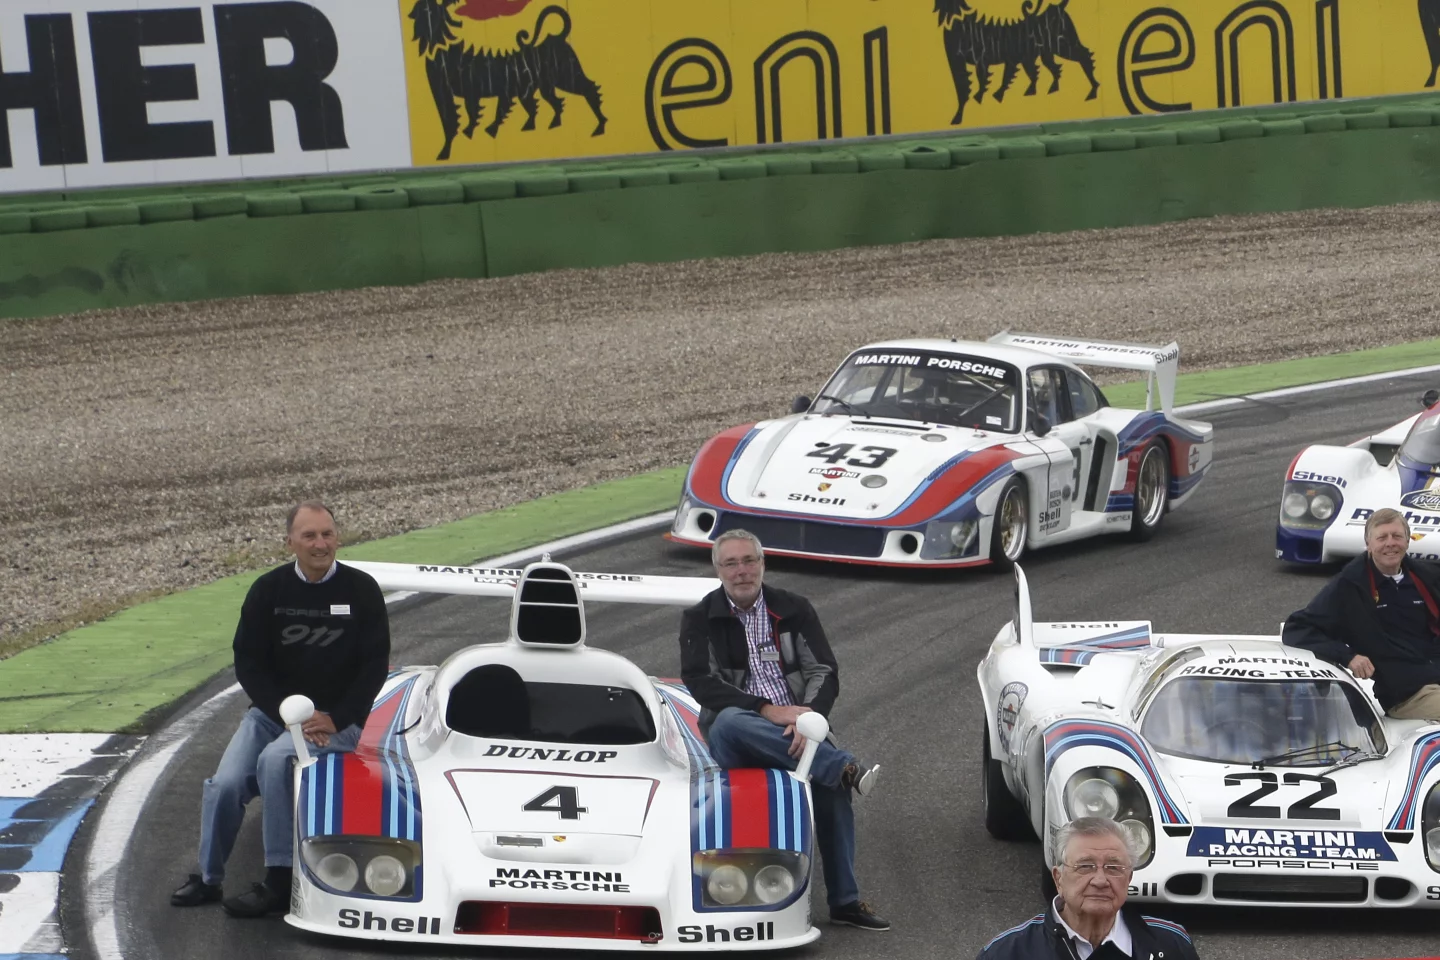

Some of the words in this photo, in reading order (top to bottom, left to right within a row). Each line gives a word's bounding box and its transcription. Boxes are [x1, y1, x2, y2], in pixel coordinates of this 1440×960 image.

[1117, 0, 1343, 115] eni
[645, 26, 892, 151] eni
[1012, 338, 1079, 349] MARTINI
[1086, 345, 1156, 357] PORSCH
[1155, 349, 1178, 364] Shell
[854, 354, 921, 366] MARTINI
[926, 357, 1007, 379] PORSCHE
[804, 442, 899, 468] 43
[810, 468, 860, 479] MARTINI
[1293, 470, 1348, 489] Shell
[787, 493, 847, 506] Shell
[1038, 508, 1061, 523] Shell
[417, 565, 523, 576] MARTINI
[280, 623, 345, 647] 911
[1217, 656, 1311, 668] MARTINI
[481, 744, 618, 763] DUNLOP
[520, 785, 589, 821] 4
[1223, 772, 1341, 820] 22
[1224, 828, 1356, 847] MARTINI
[1207, 859, 1380, 871] PORSCHE
[495, 868, 623, 882] MARTINI
[488, 879, 631, 893] PORSCHE
[337, 908, 441, 935] Shell
[677, 921, 774, 943] Shell
